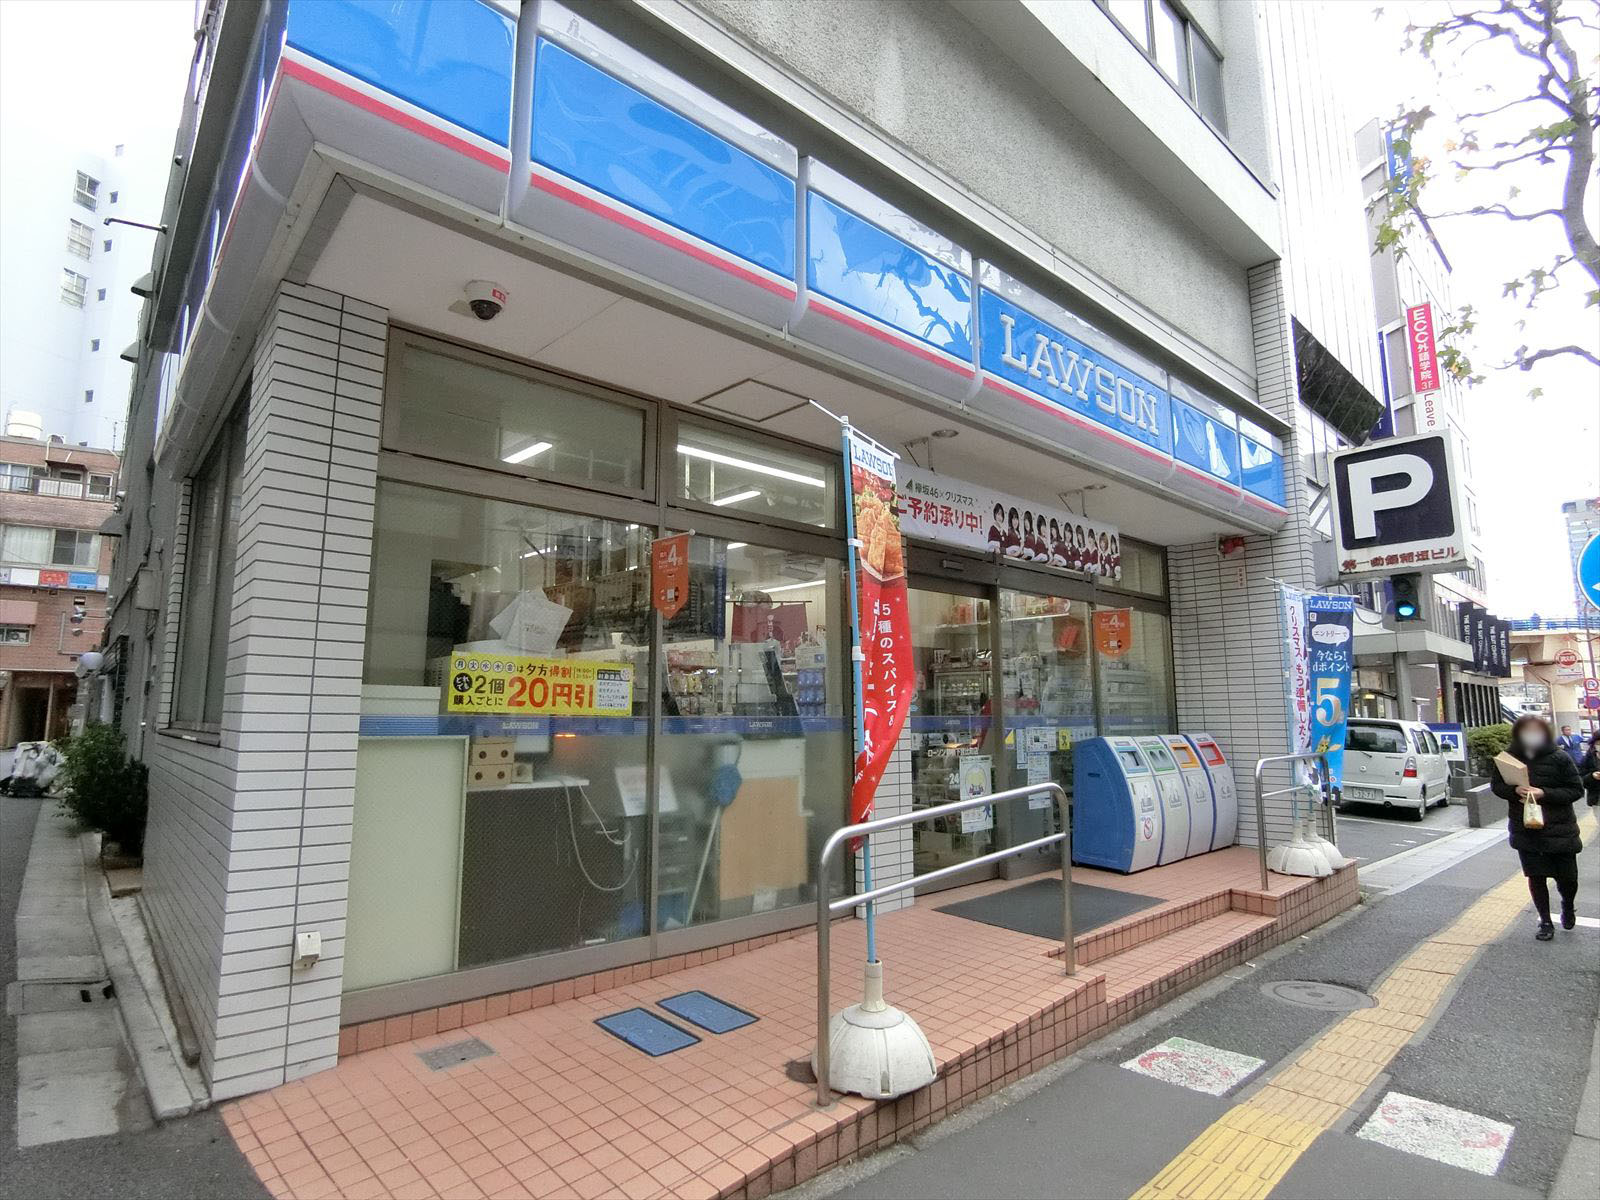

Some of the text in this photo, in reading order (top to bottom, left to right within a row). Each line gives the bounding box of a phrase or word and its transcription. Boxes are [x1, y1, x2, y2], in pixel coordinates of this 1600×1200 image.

[1412, 308, 1433, 390] ECC外語学院 3F
[1000, 312, 1159, 437] LAWSON
[1424, 393, 1436, 427] Leave
[1347, 453, 1434, 540] P
[1310, 600, 1352, 610] LAWSON
[1312, 662, 1350, 672] dポイント
[1316, 650, 1347, 661] 今なら!
[507, 675, 593, 709] 20円引
